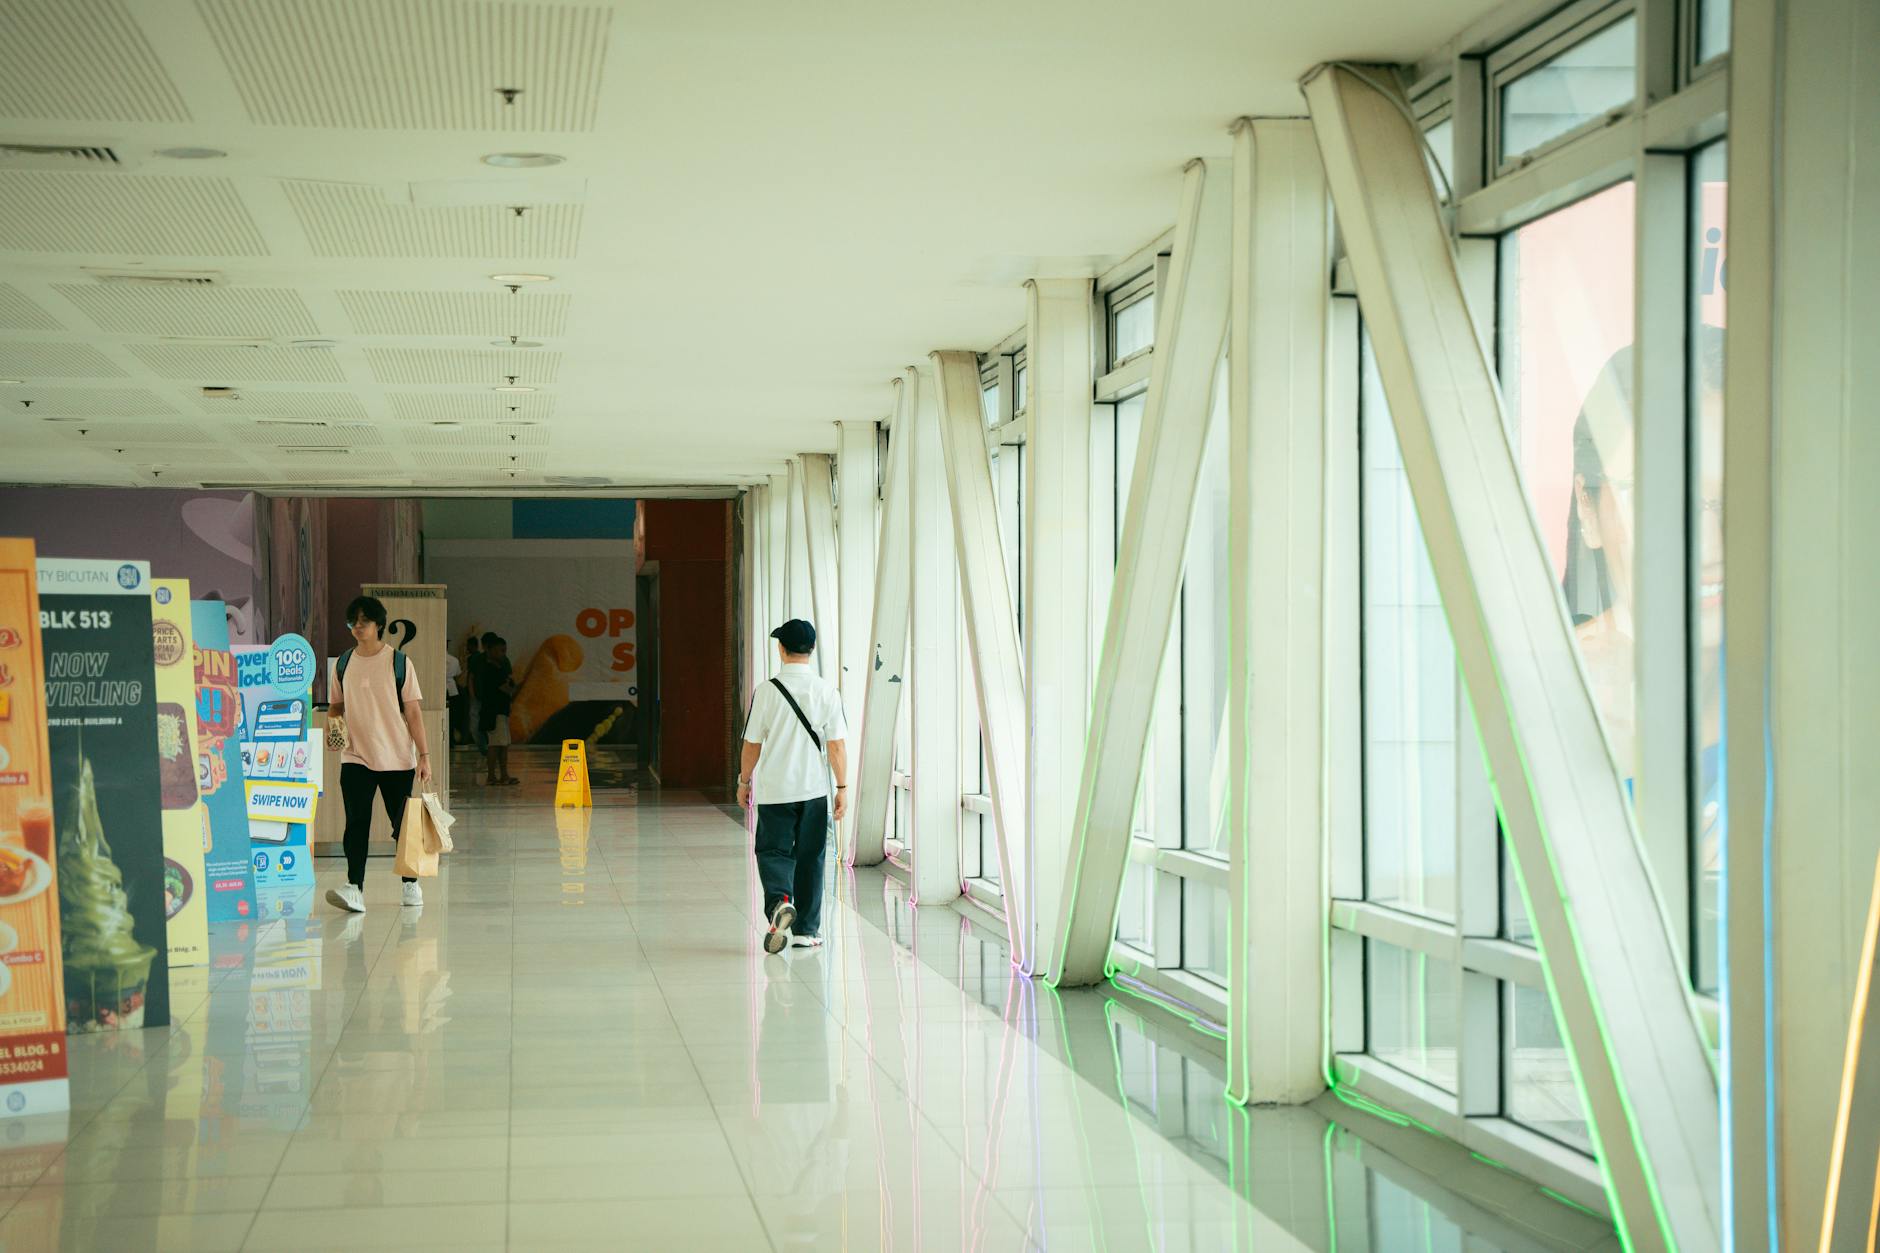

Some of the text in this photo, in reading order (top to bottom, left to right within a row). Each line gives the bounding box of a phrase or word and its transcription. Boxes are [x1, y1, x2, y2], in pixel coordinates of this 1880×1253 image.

[56, 571, 109, 582] BICUTAN
[371, 589, 436, 598] INFORMATION
[40, 611, 111, 628] BLK 513
[576, 608, 634, 638] OP
[153, 628, 174, 636] PRICE
[50, 653, 109, 677] NOW
[194, 650, 231, 677] PIN
[236, 652, 269, 667] over
[276, 650, 306, 666] 100+
[611, 642, 635, 672] S
[239, 667, 271, 687] lock
[278, 664, 303, 676] Deals
[45, 682, 142, 707] WIRLING
[252, 794, 308, 809] SWIPE NOW
[14, 1044, 48, 1058] BLDG.
